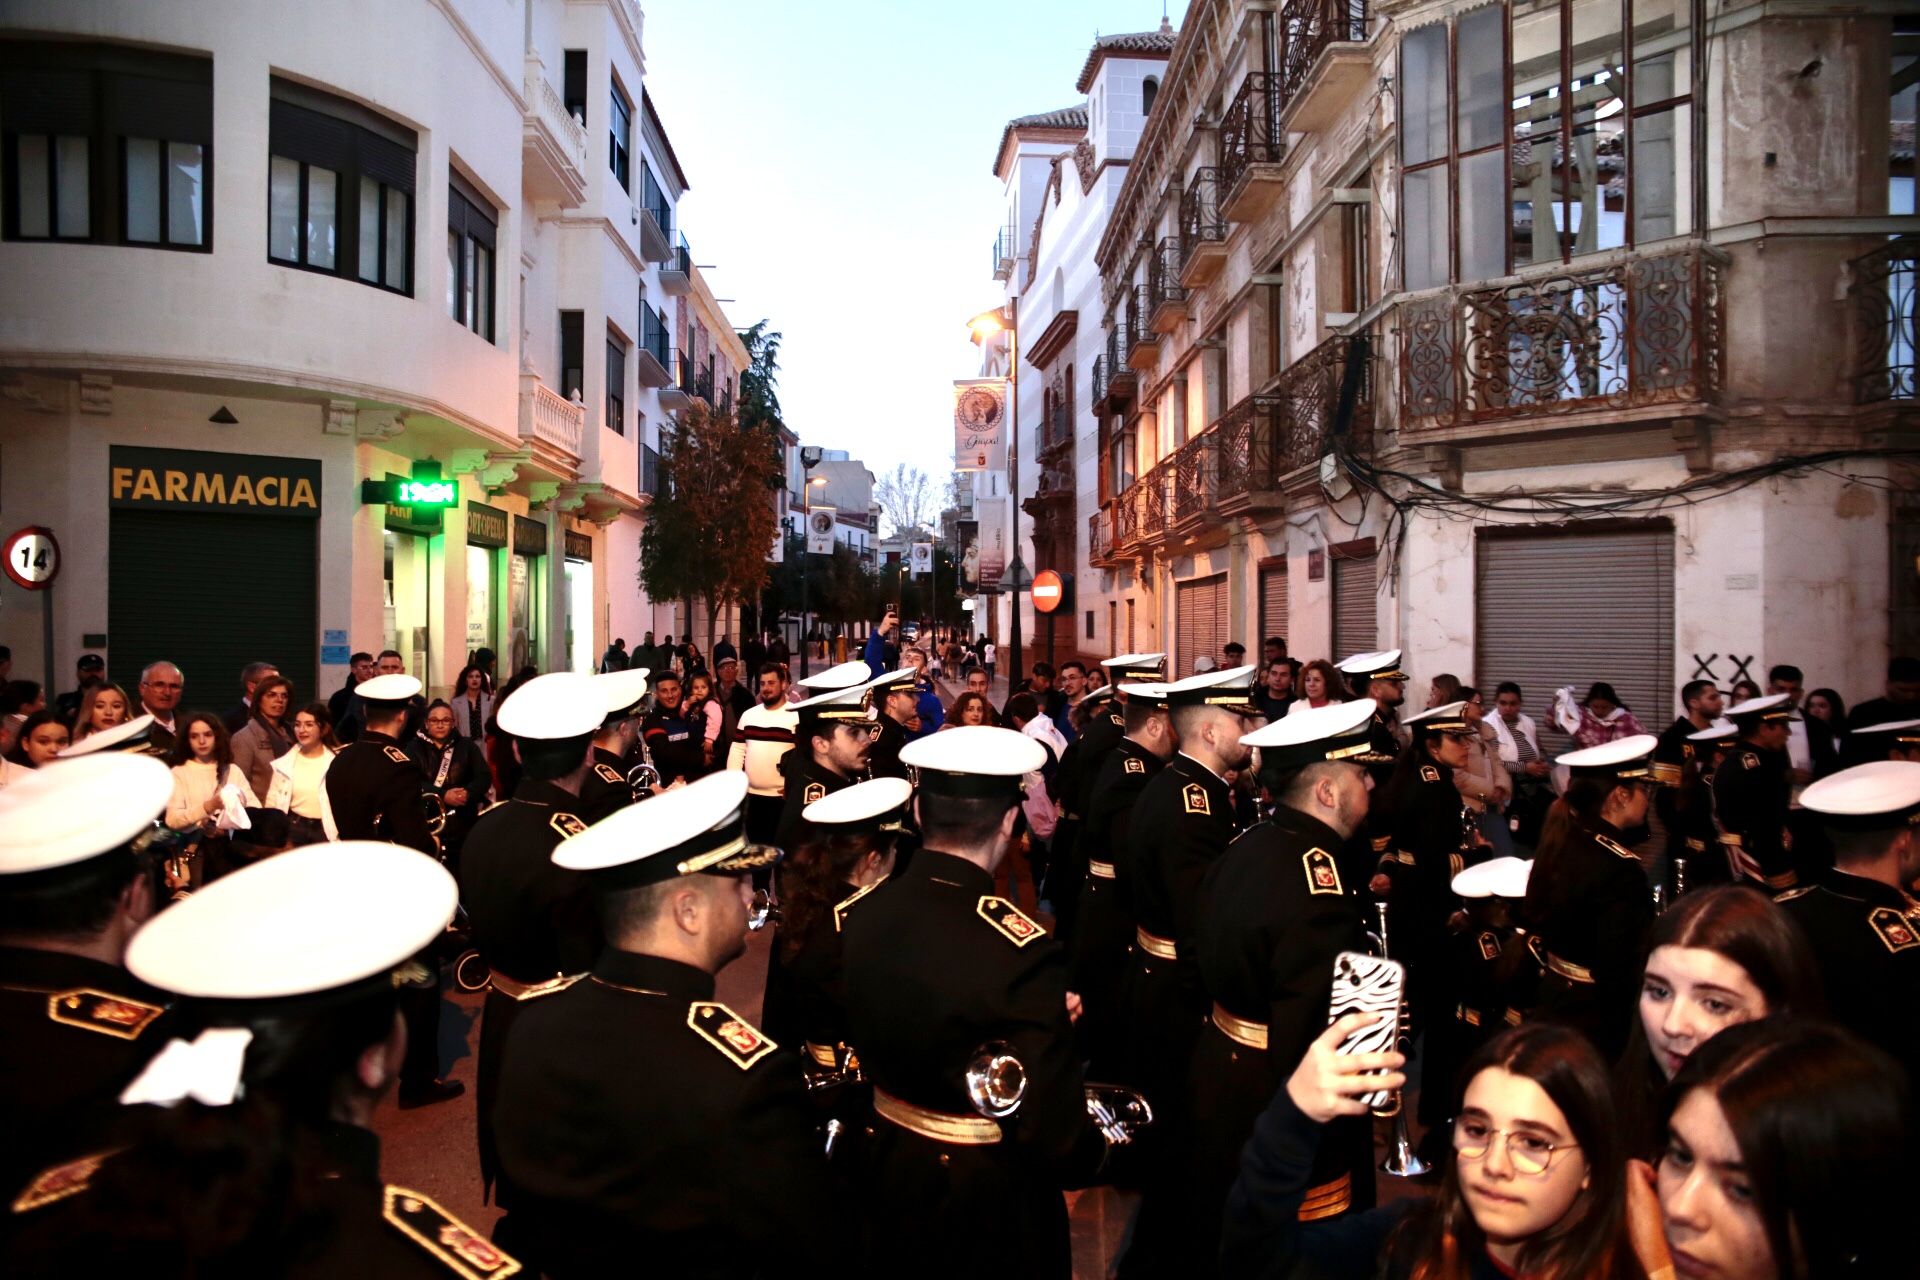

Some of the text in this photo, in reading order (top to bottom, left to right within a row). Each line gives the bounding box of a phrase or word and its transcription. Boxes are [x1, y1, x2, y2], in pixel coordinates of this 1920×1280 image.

[112, 467, 318, 509] FARMACIA
[467, 511, 506, 540] ORTOPEDIA
[21, 547, 47, 571] 14
